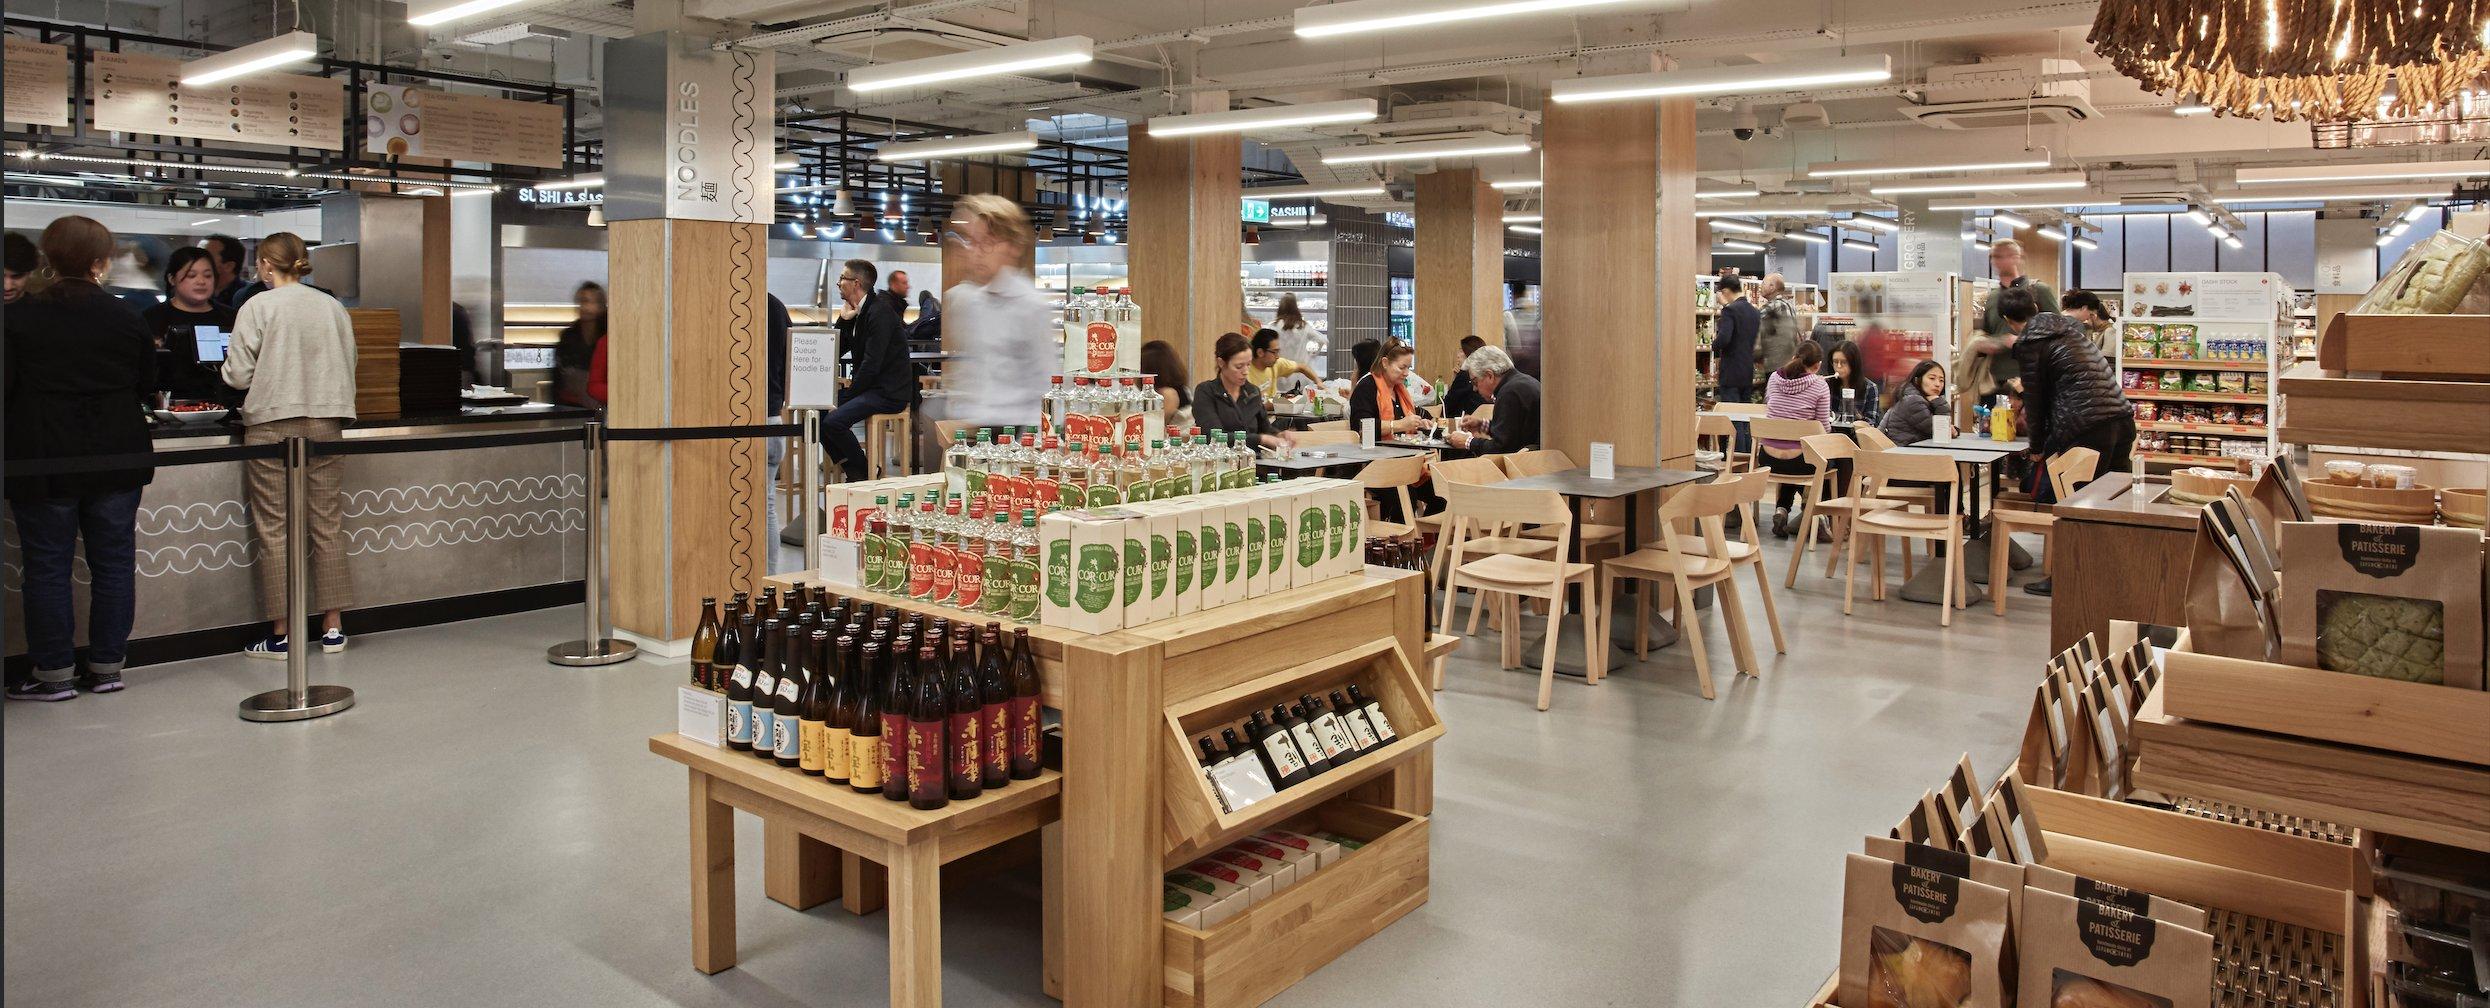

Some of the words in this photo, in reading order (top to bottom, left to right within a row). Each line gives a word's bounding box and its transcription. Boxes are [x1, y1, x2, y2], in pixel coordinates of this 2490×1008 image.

[678, 81, 699, 201] NOODLES
[1270, 206, 1315, 217] SASHIMI
[1904, 209, 1915, 270] GROCERY
[794, 337, 818, 345] Please
[2360, 525, 2397, 535] BAKERY
[2351, 541, 2406, 555] PATISSERIE
[867, 555, 883, 564] COR
[888, 560, 904, 569] COR
[916, 564, 934, 573] COR
[937, 569, 954, 578] COR
[963, 575, 980, 583] COR
[1078, 570, 1096, 581] COR
[992, 580, 1010, 589] COR
[1018, 584, 1038, 593] COR
[1910, 866, 1941, 884] BAKERY
[1903, 883, 1948, 905] PATISSERIE
[2094, 880, 2129, 897] BAKERY
[2098, 904, 2134, 923] BAKERY
[2089, 922, 2142, 945] PATISSERIE
